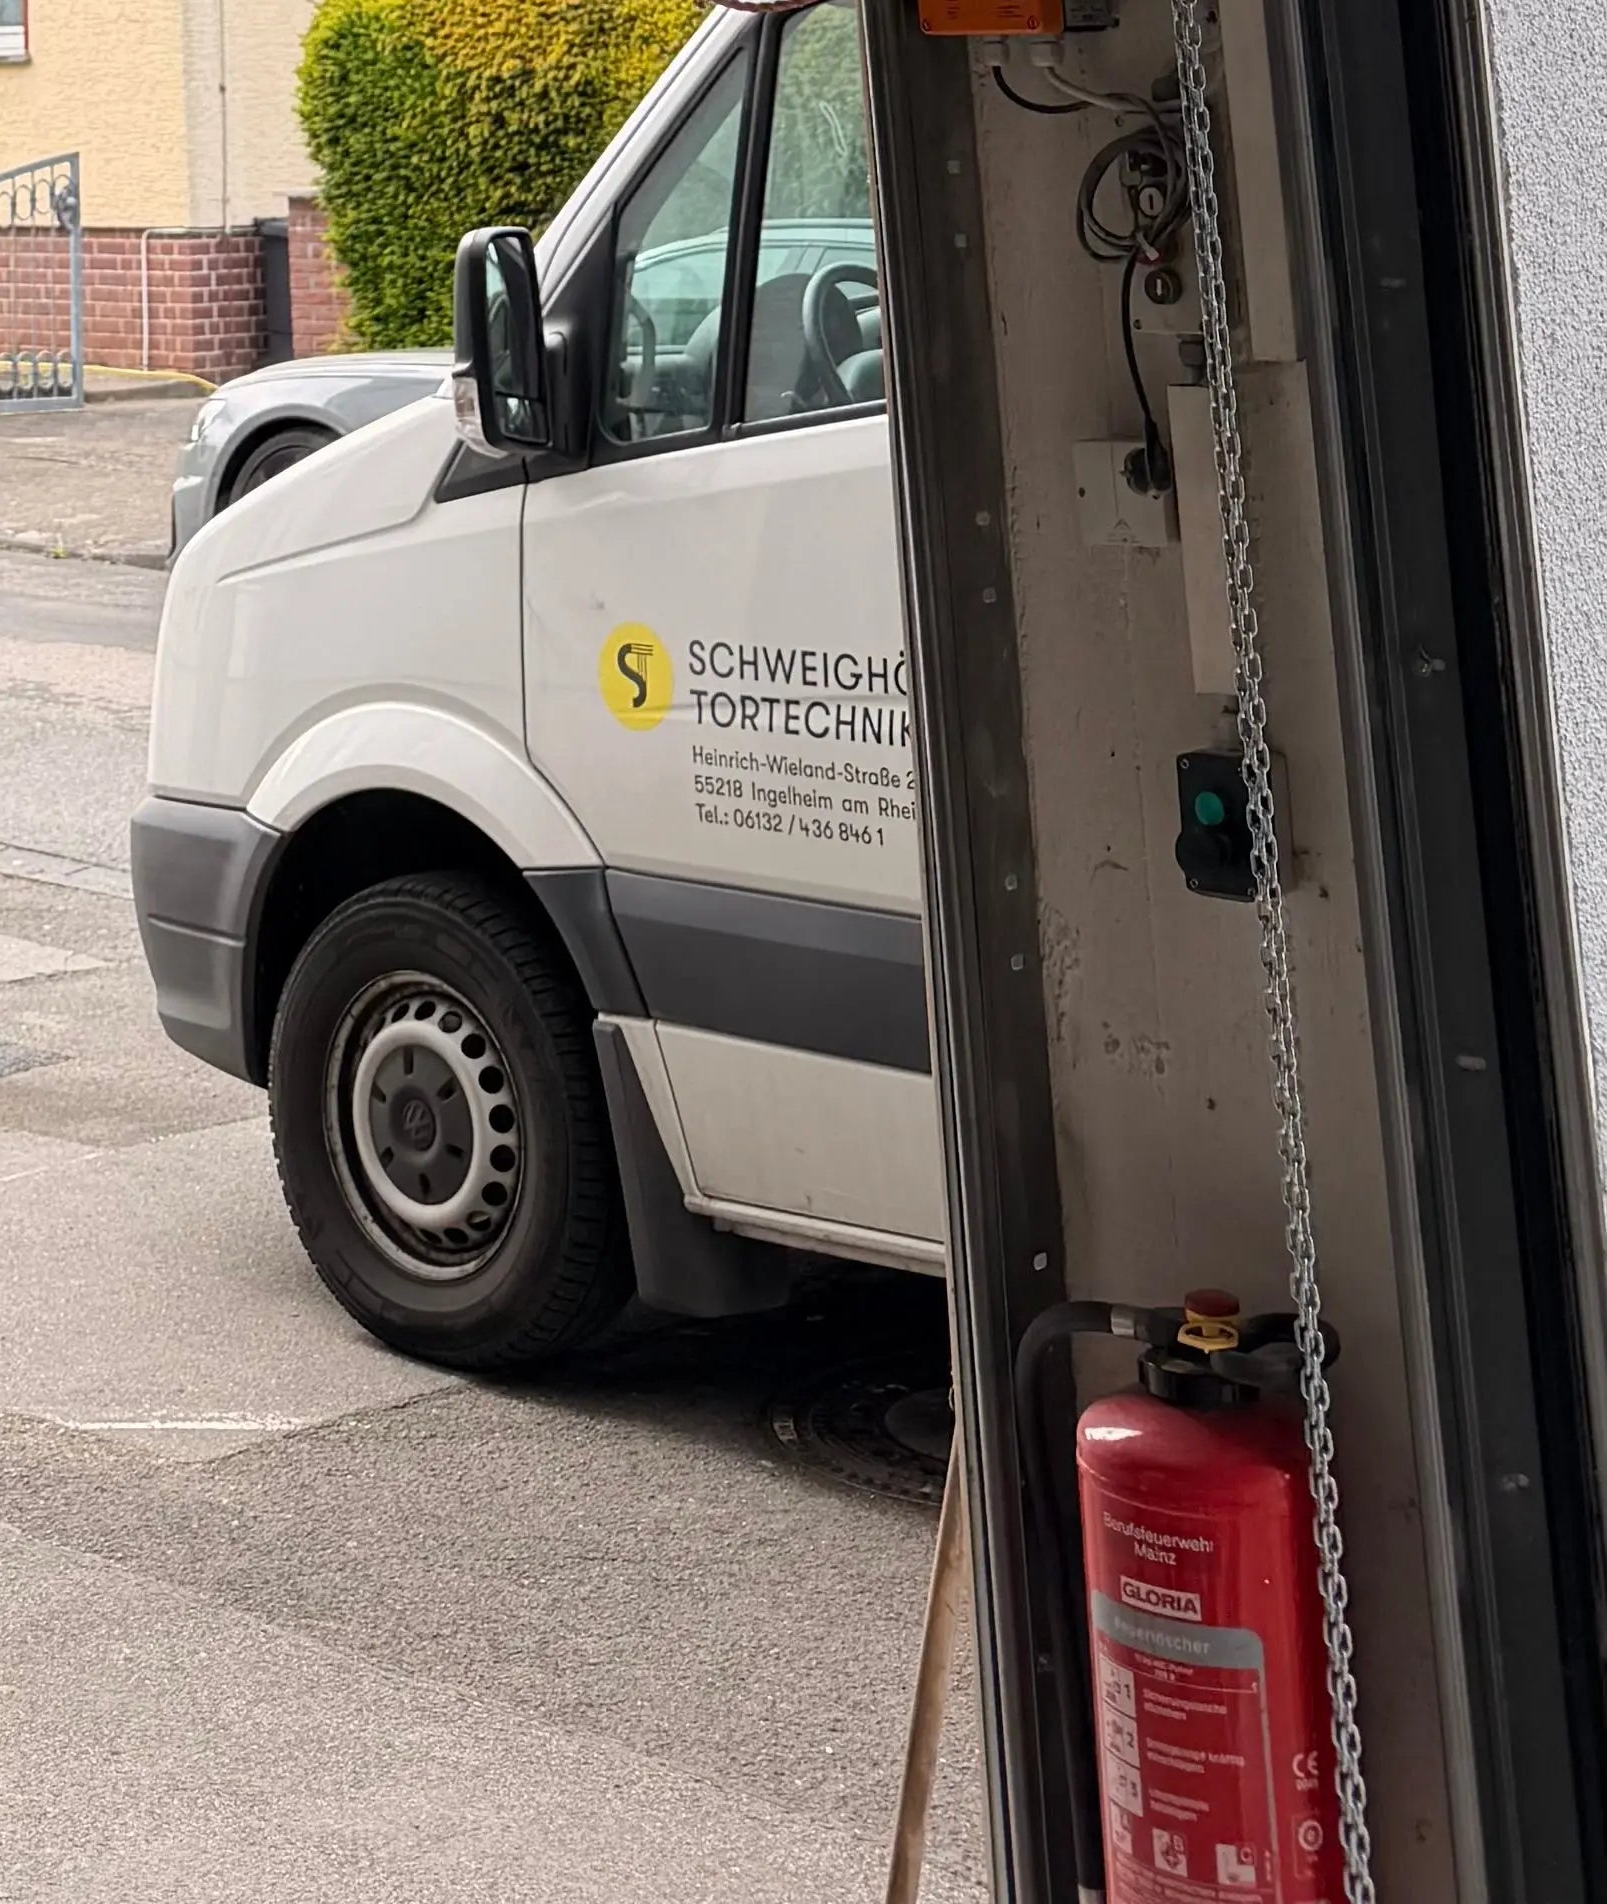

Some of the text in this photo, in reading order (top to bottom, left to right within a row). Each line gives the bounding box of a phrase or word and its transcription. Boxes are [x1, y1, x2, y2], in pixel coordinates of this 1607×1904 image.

[689, 689, 911, 747] TORTECHNIK
[692, 745, 901, 789] Heinrich-Wieland-Straße
[694, 775, 743, 798] 55218
[751, 782, 833, 810] Ingelheim
[842, 798, 869, 815] am
[695, 803, 729, 826] Tel.:
[733, 808, 783, 833] 06132
[799, 818, 834, 840] 436
[1103, 1511, 1213, 1553] Berufsfeuerwehr
[1134, 1541, 1177, 1565] Mainz
[1122, 1581, 1198, 1614] GLORIA
[1126, 1731, 1134, 1748] 2
